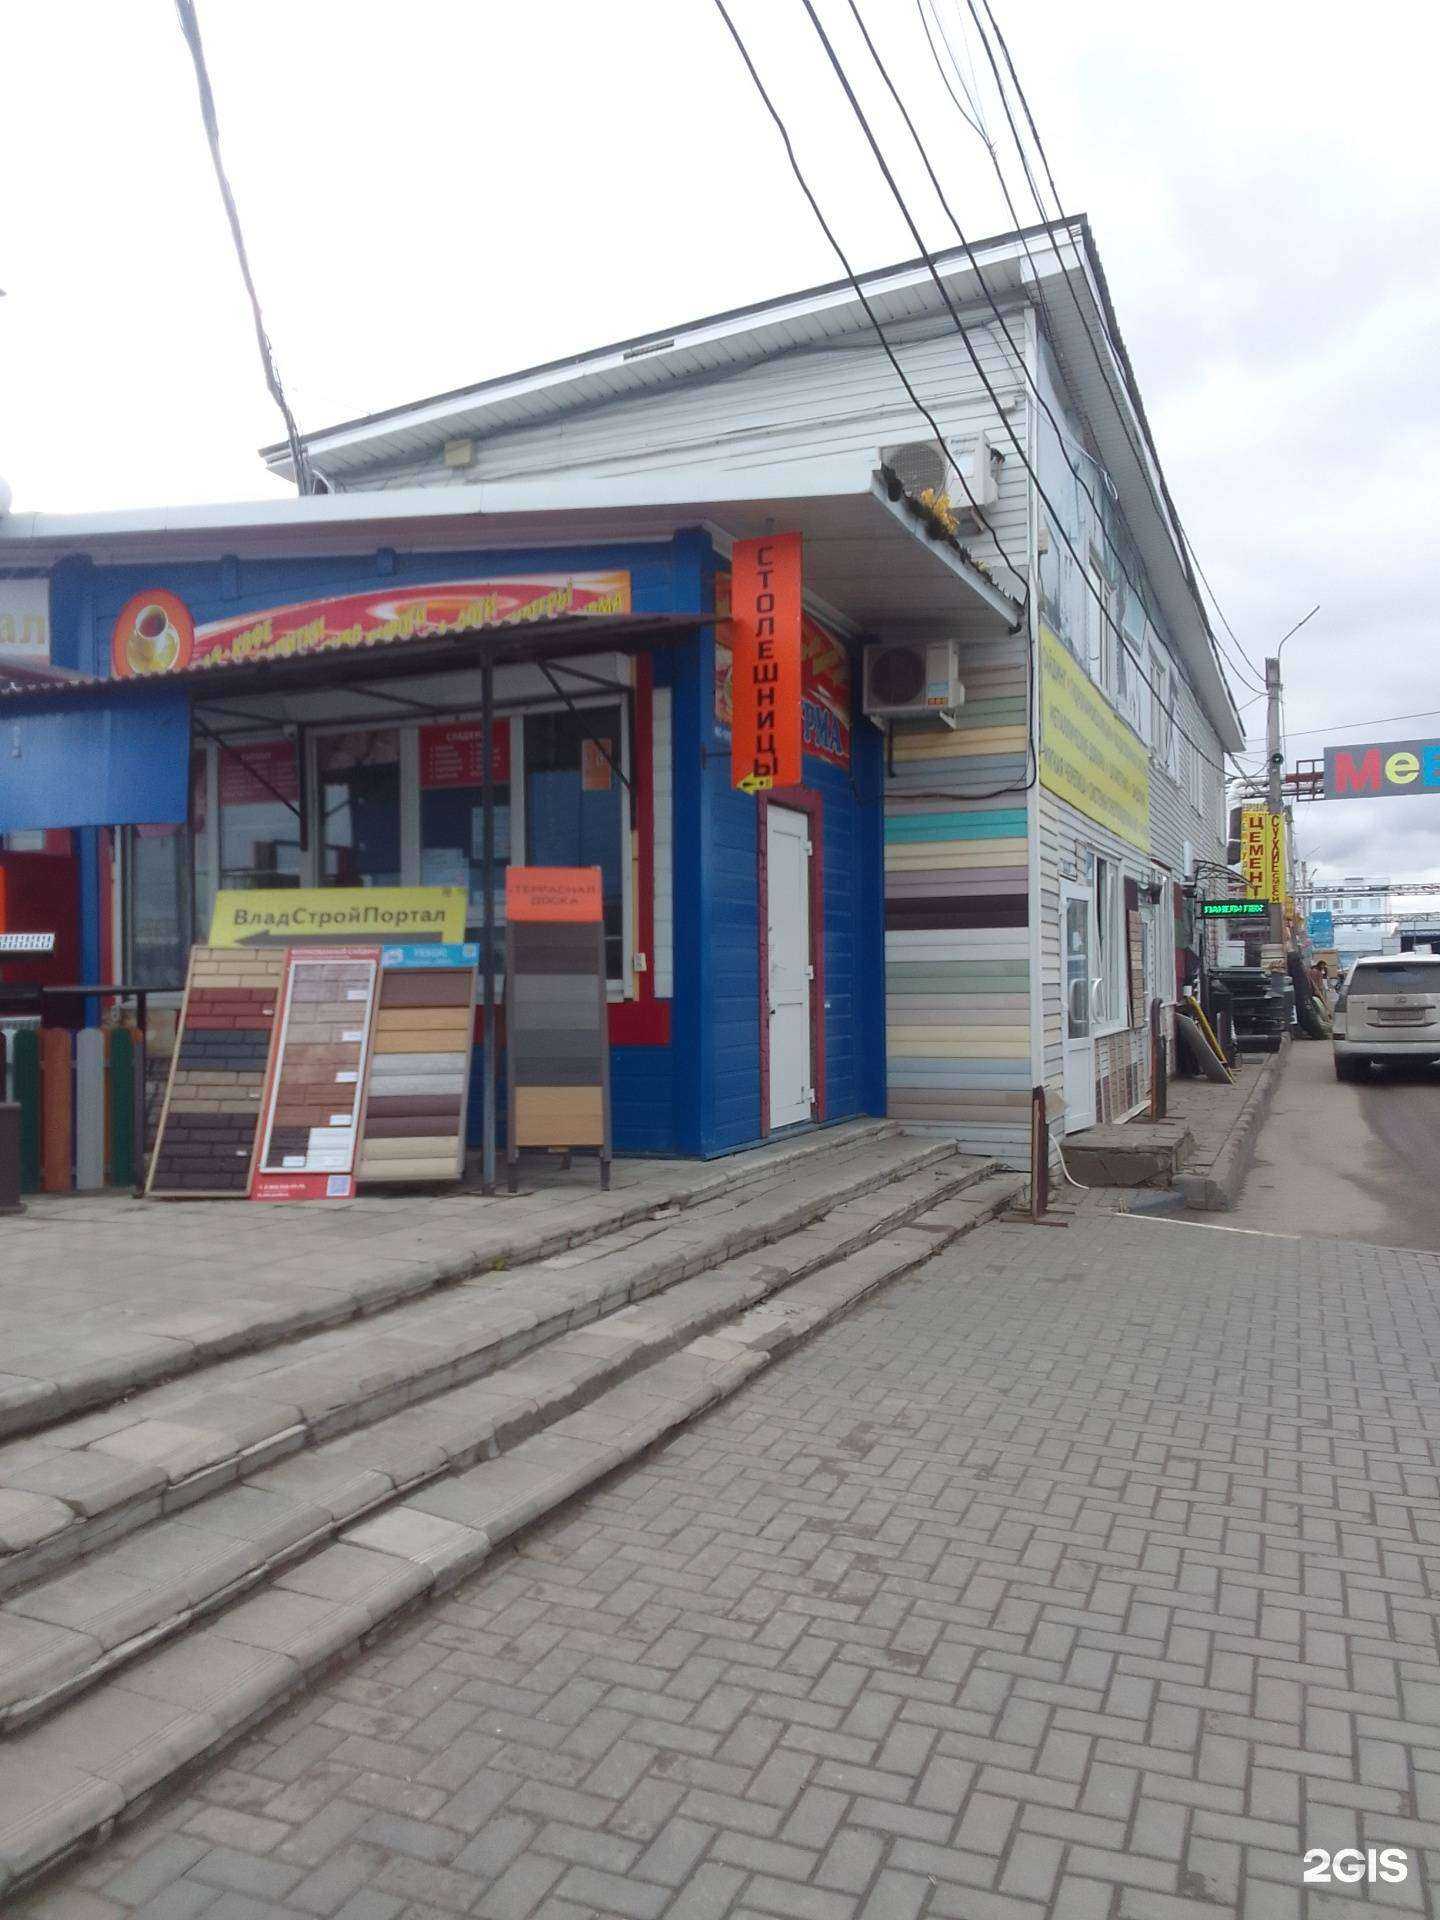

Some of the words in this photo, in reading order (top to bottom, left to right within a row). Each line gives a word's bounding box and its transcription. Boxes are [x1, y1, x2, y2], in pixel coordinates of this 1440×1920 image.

[753, 546, 778, 777] СТОЛЕШНИЦЫ
[1249, 816, 1264, 896] ЦЕМЕНТ
[233, 908, 446, 927] ВладСтройПортал
